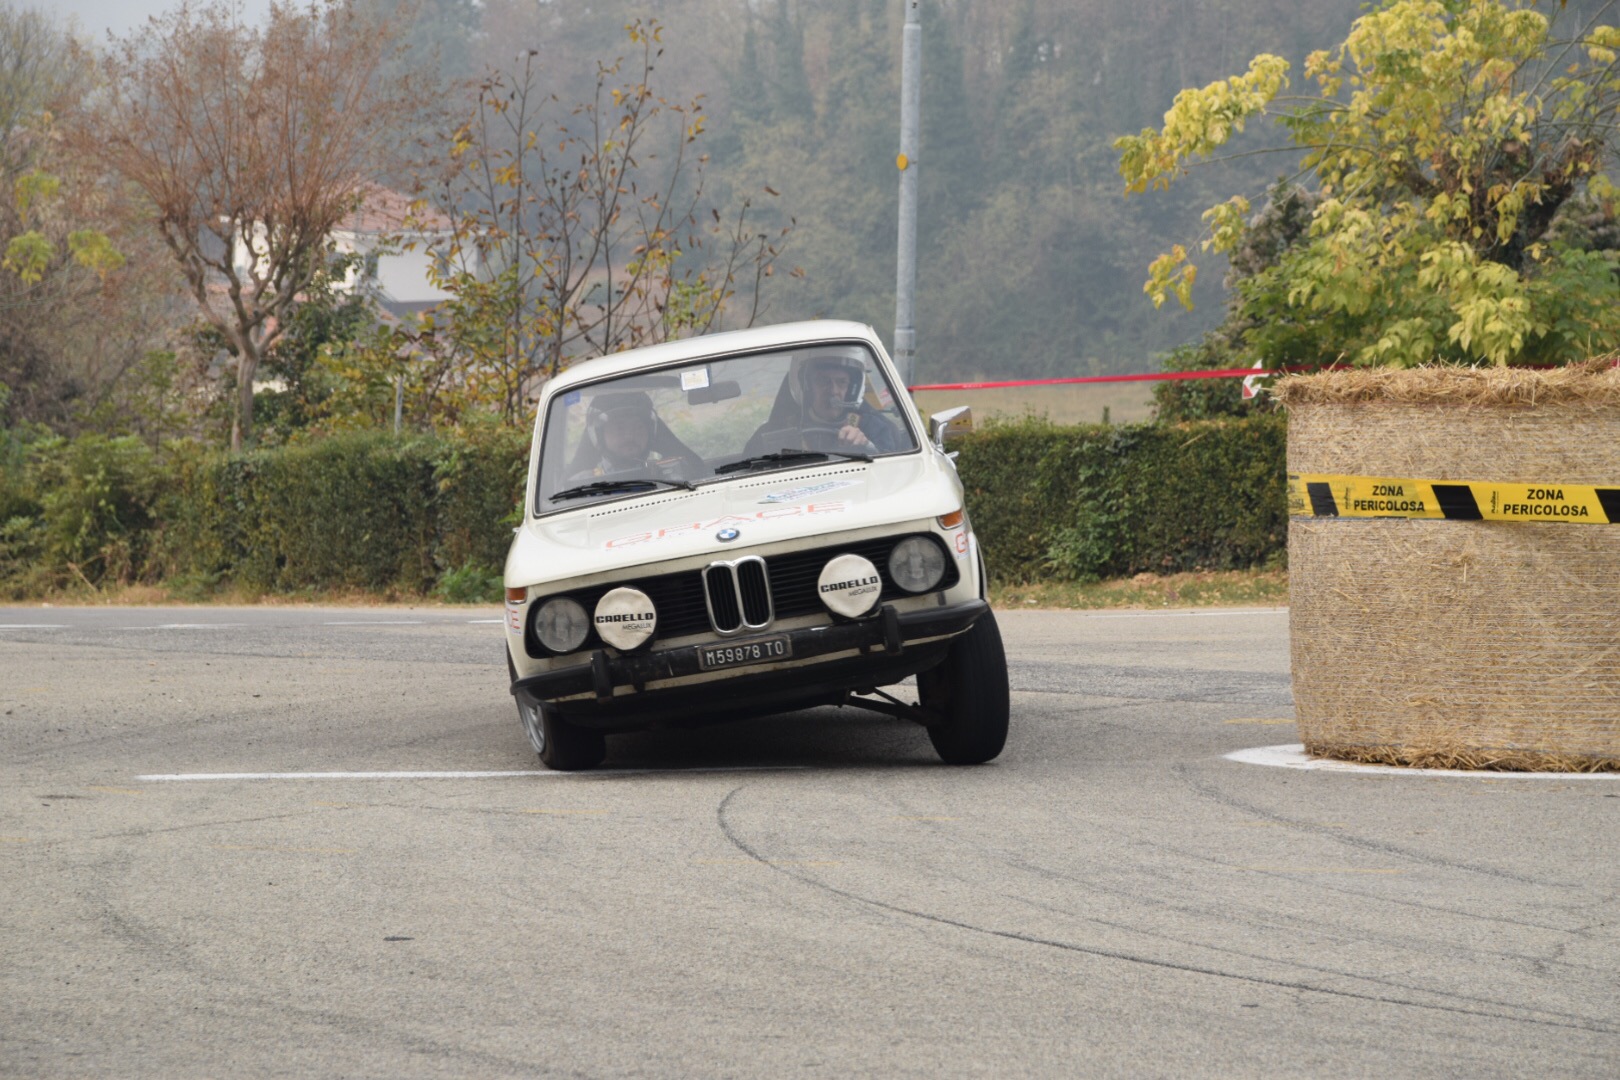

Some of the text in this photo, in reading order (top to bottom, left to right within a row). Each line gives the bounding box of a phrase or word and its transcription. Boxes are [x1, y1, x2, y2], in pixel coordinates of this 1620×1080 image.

[1372, 485, 1404, 497] ZONA
[1526, 488, 1565, 501] ZONA
[1354, 499, 1426, 512] PERICOLOSA
[1503, 503, 1589, 517] PERICOLOSA
[820, 575, 879, 593] CARELLO
[595, 612, 654, 624] CARELLO
[706, 644, 761, 666] M59878
